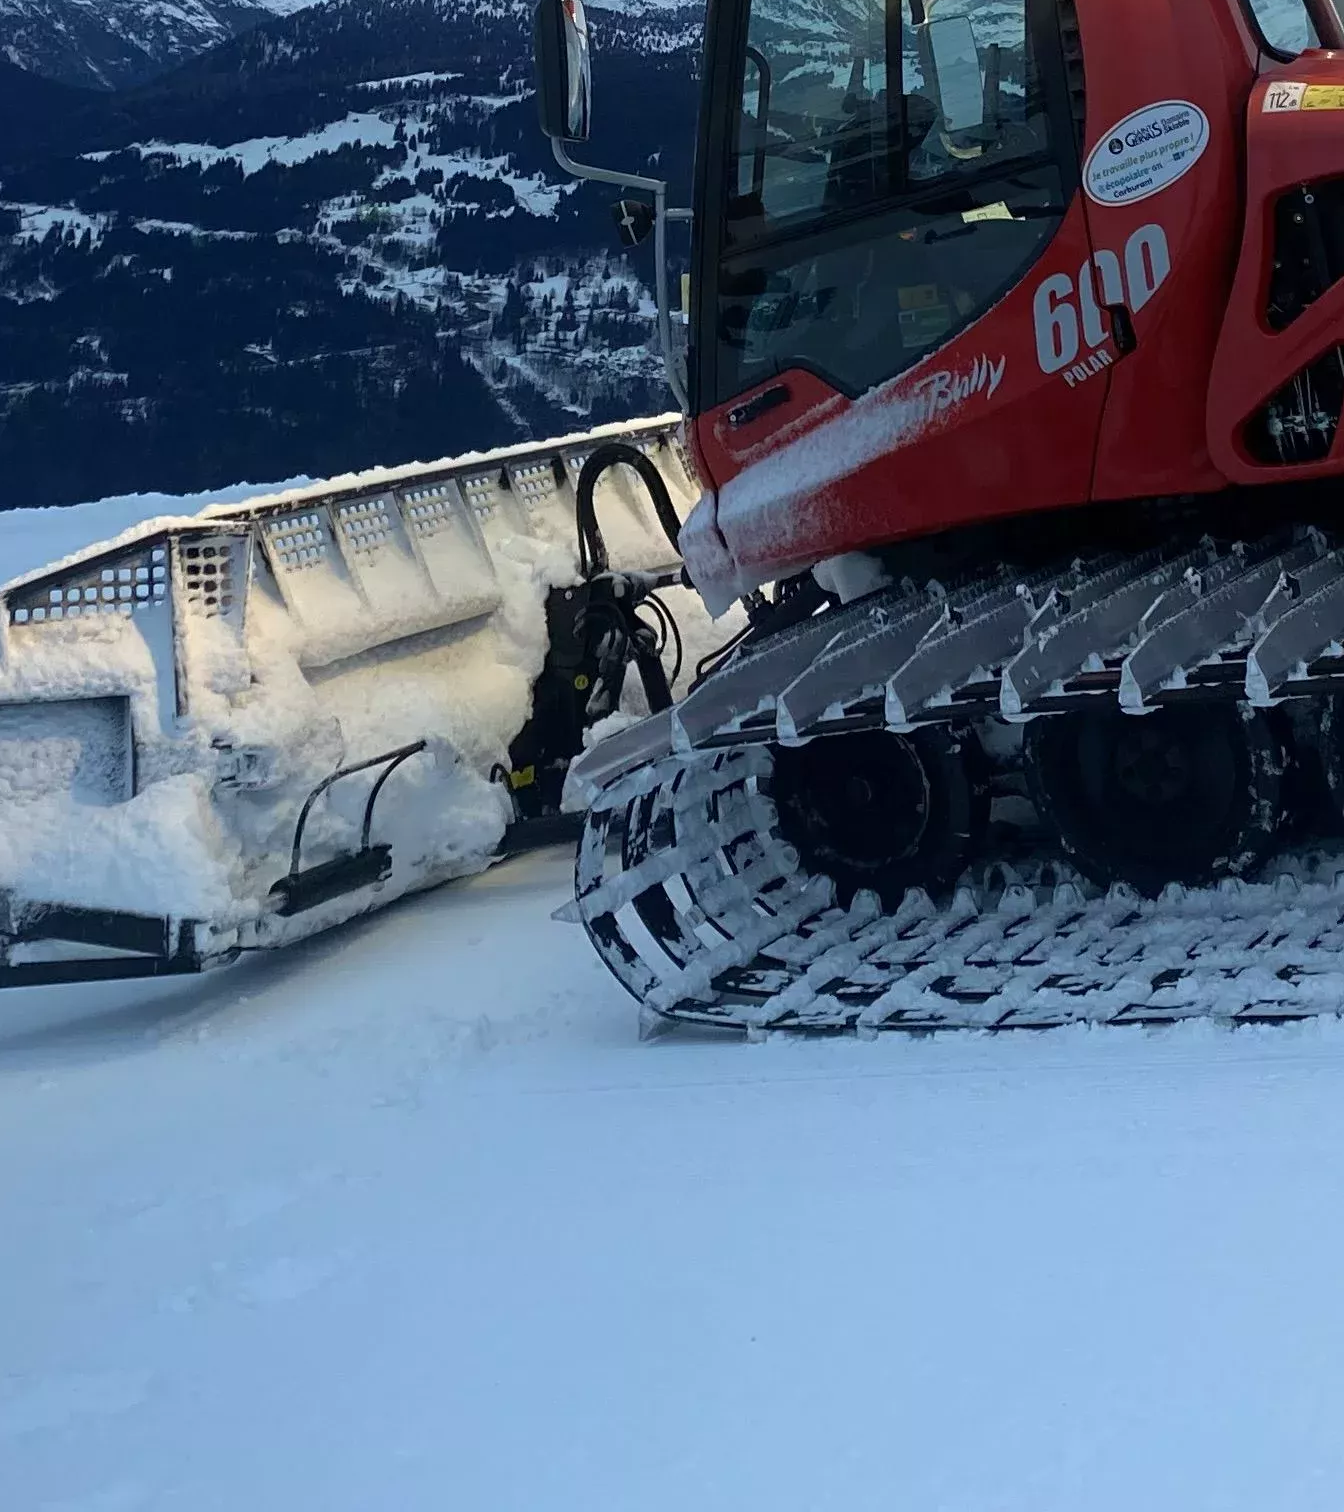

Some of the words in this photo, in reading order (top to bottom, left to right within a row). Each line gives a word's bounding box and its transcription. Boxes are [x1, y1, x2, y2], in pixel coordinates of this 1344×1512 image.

[1269, 92, 1290, 109] 112
[1102, 156, 1137, 177] travaille
[1140, 149, 1158, 164] plus
[1159, 136, 1191, 155] propre
[1033, 224, 1171, 374] 600
[1062, 349, 1113, 388] POLAR
